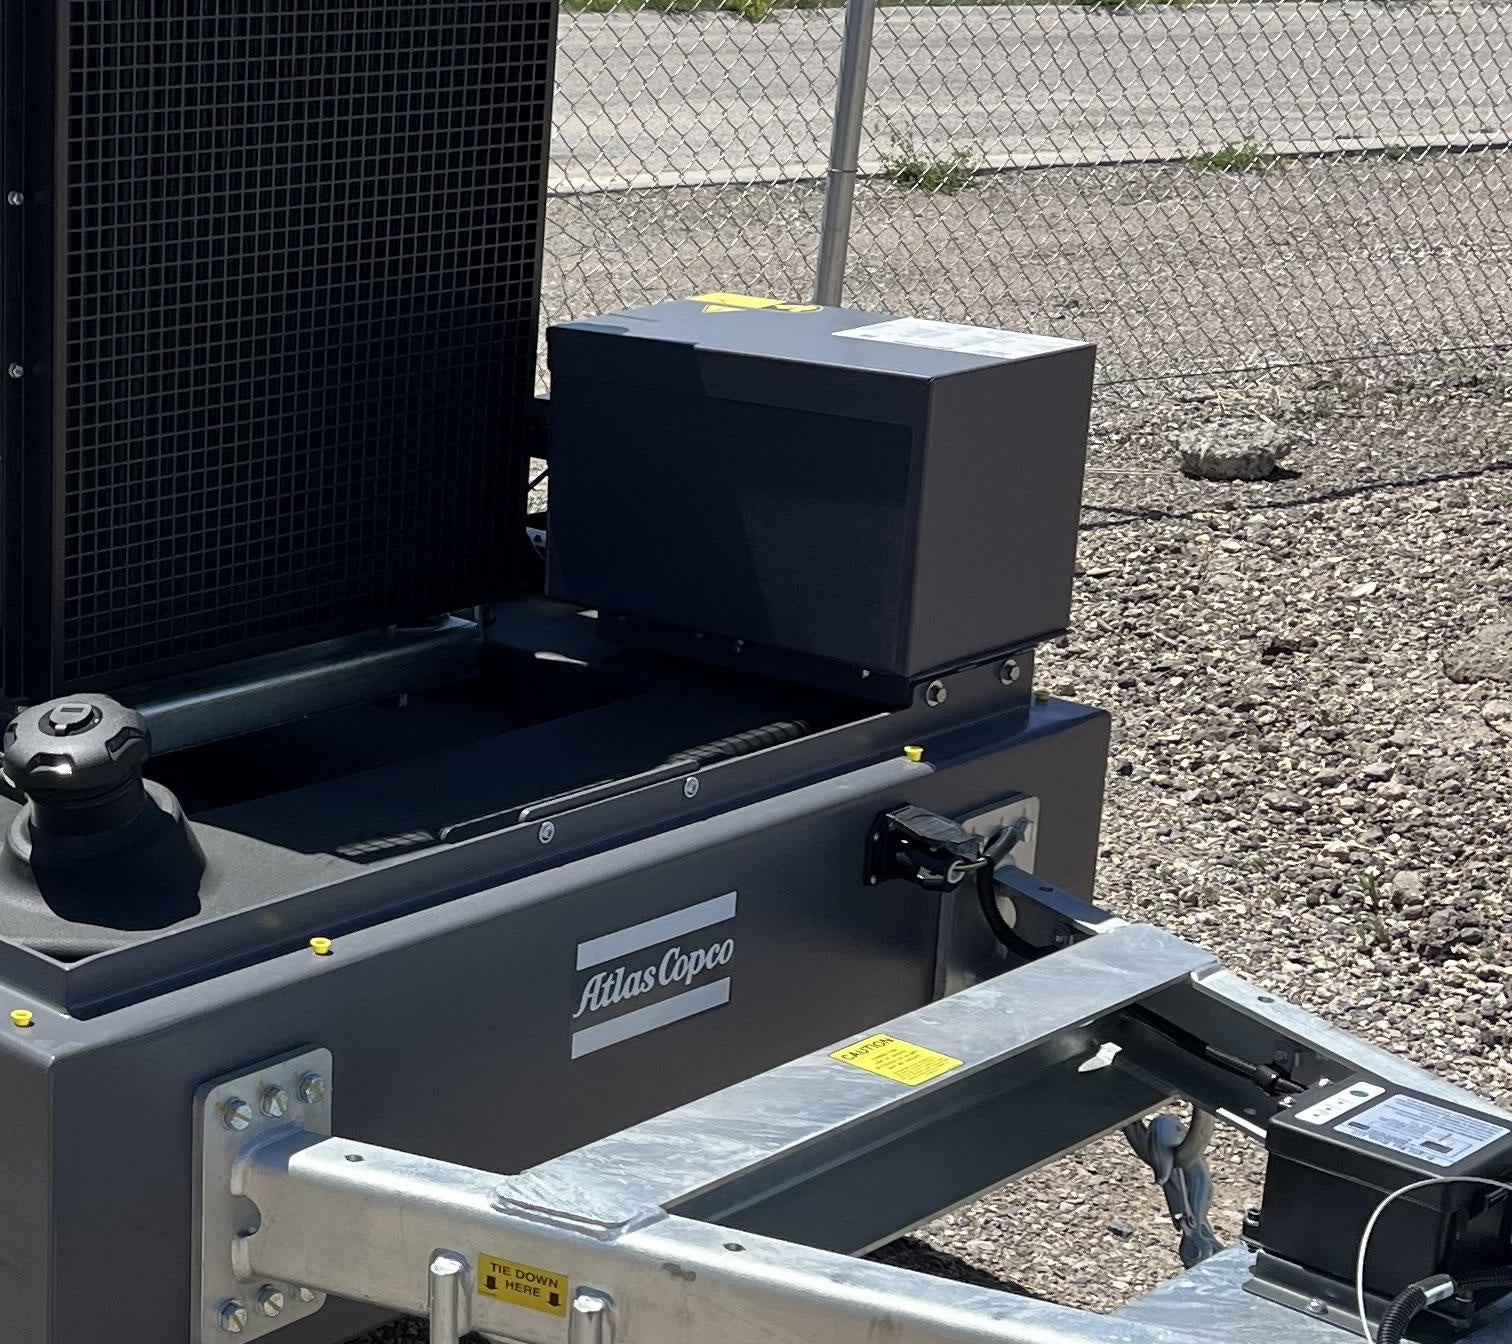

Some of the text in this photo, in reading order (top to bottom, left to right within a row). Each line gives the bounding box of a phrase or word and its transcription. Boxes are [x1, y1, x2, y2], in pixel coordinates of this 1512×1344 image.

[572, 937, 735, 1019] Atlas Copco
[841, 1036, 895, 1061] CAUTION
[489, 1261, 559, 1289] TIE DOWN
[505, 1279, 542, 1298] HERE
